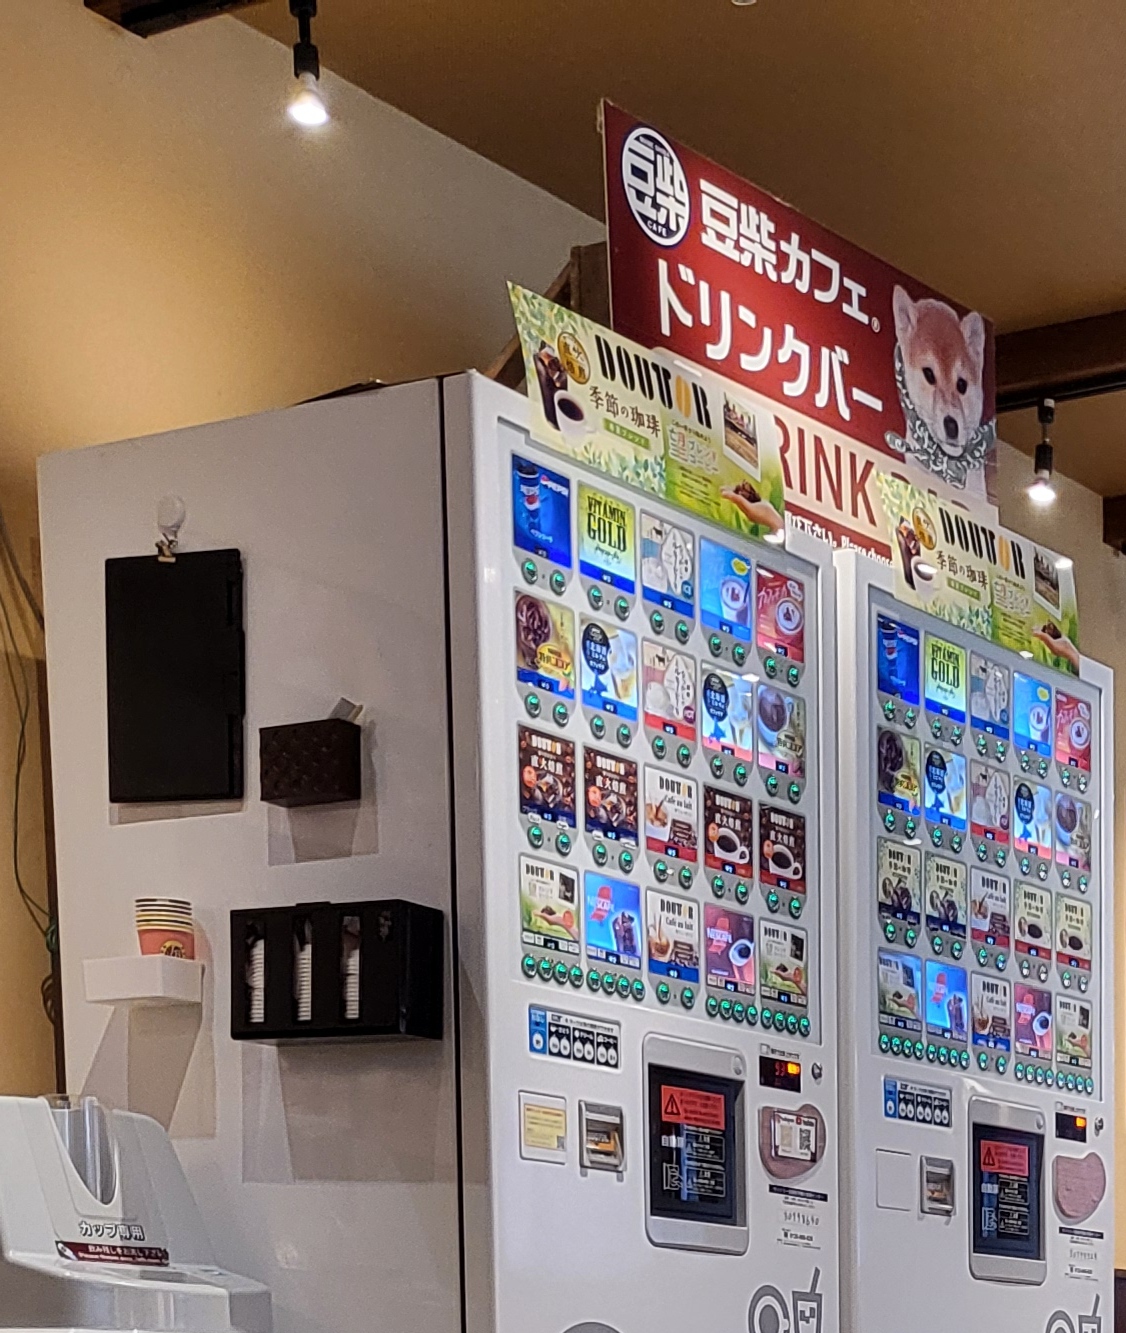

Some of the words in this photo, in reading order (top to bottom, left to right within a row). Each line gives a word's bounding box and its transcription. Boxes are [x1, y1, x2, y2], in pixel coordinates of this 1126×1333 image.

[647, 220, 668, 237] CAFE
[699, 178, 870, 325] 豆柴カフェ
[657, 258, 884, 421] ドリンクバー
[595, 334, 712, 429] DOUTOR
[589, 385, 661, 438] 季節の珈琲
[774, 415, 877, 527] RINK
[587, 496, 626, 526] VITAMIN
[587, 513, 627, 552] GOLD
[939, 507, 1025, 579] DOUTOR
[936, 550, 988, 590] 季節の珈琲
[931, 657, 960, 689] GOLD
[659, 776, 692, 799] DOUTOR
[661, 899, 694, 920] DOUTOR
[79, 1220, 145, 1241] カップ専用
